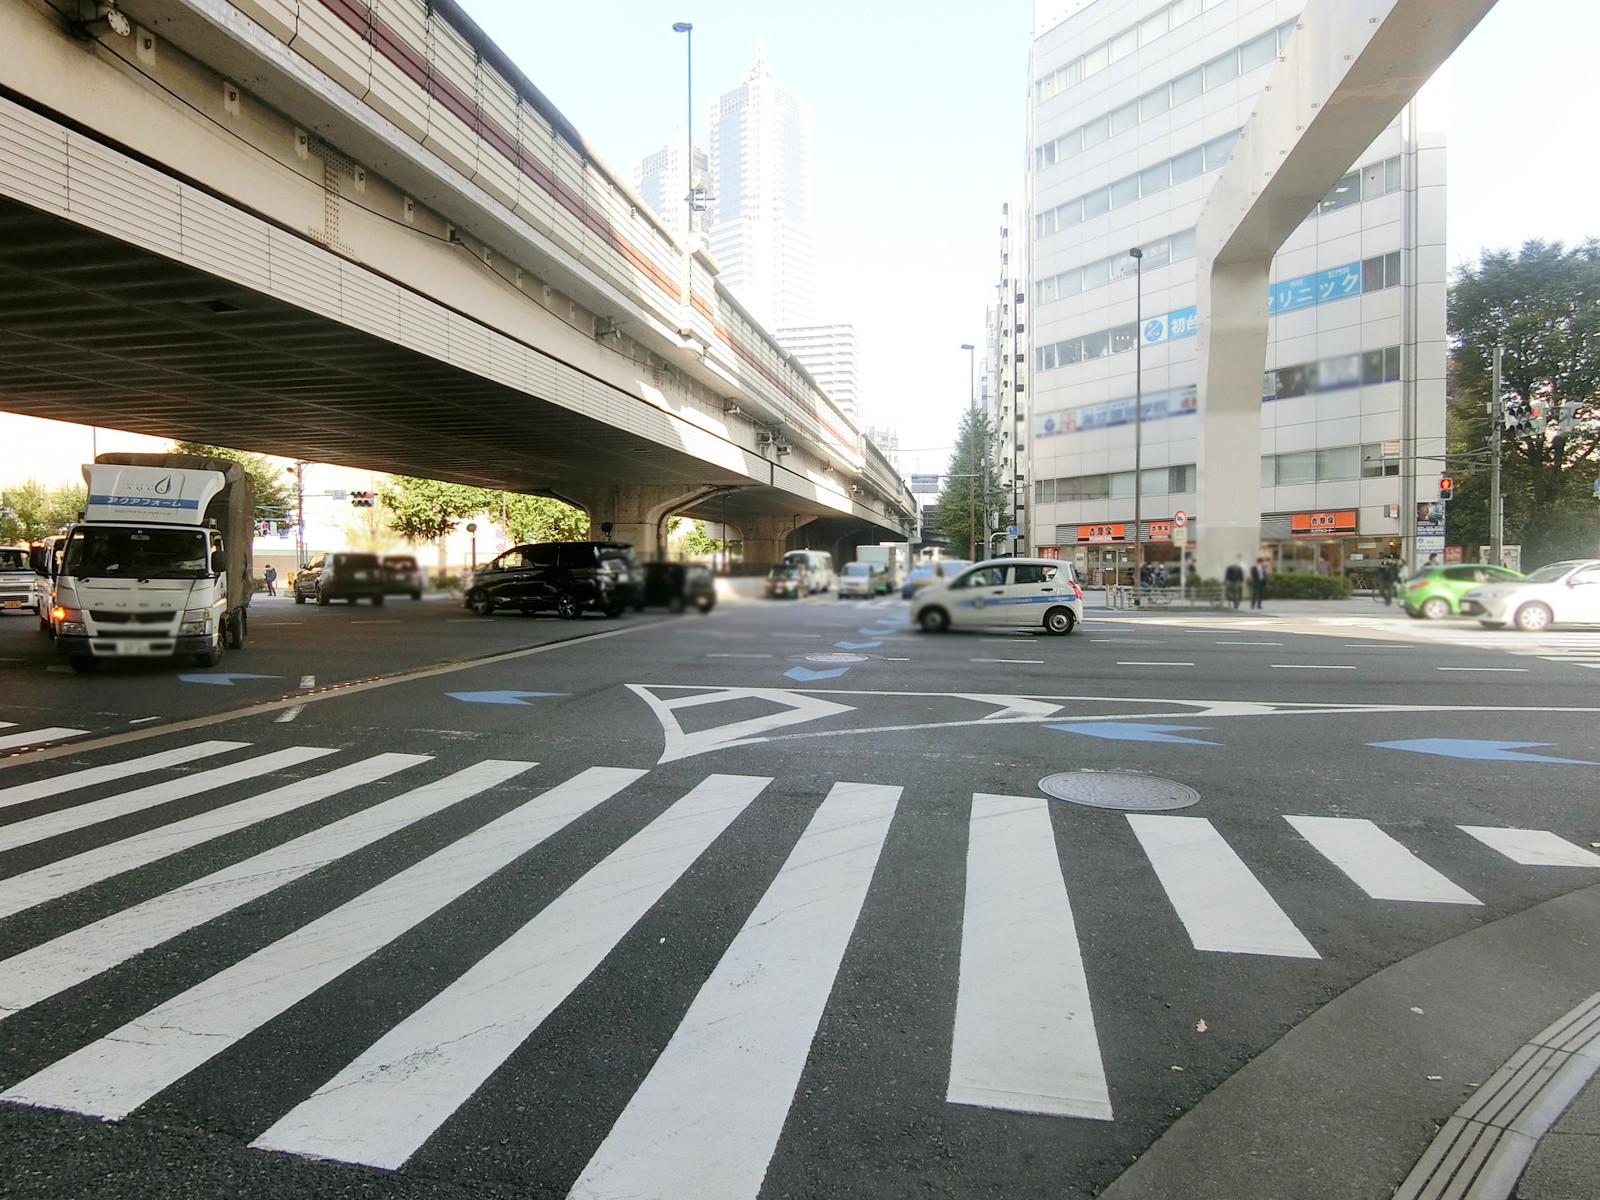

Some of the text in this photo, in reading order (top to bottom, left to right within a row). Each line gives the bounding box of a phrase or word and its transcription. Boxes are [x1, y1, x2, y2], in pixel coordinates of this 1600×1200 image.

[107, 497, 181, 507] アクアフォーム
